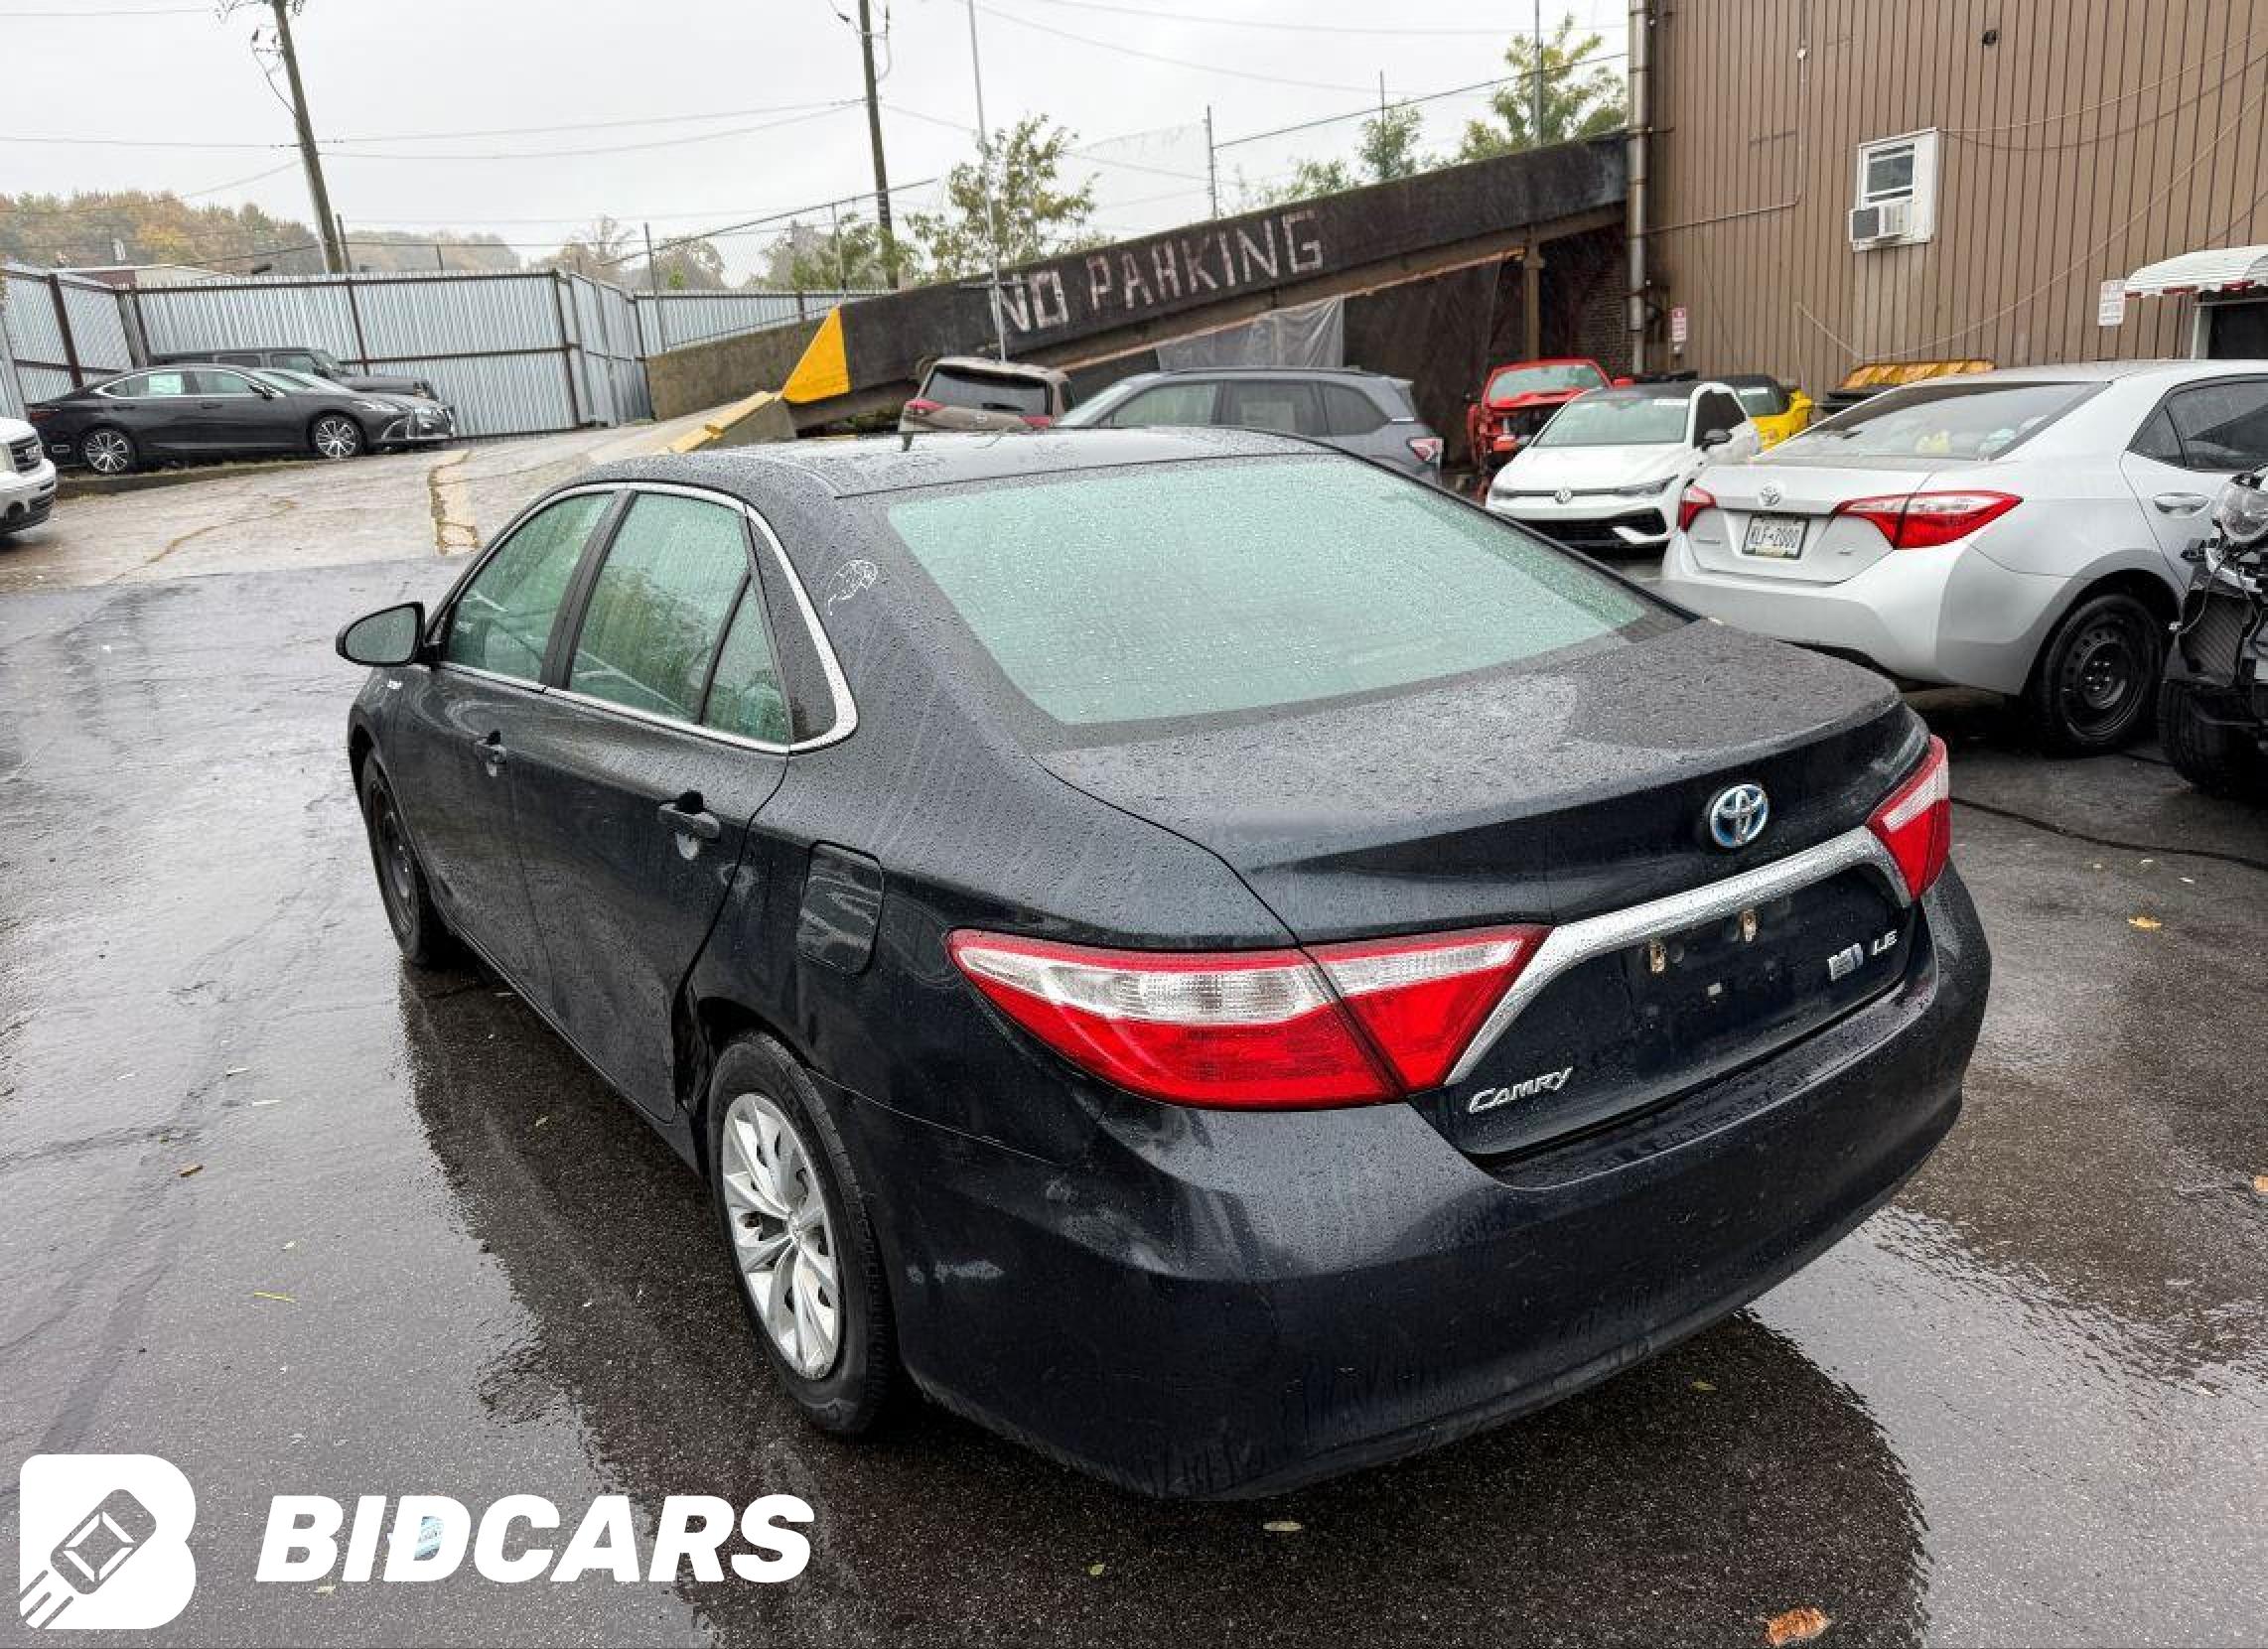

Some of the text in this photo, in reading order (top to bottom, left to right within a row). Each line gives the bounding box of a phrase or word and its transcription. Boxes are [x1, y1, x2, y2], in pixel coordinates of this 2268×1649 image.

[987, 270, 1069, 333] NO
[1871, 928, 1898, 955] LE
[1469, 1066, 1573, 1114] CAMRY
